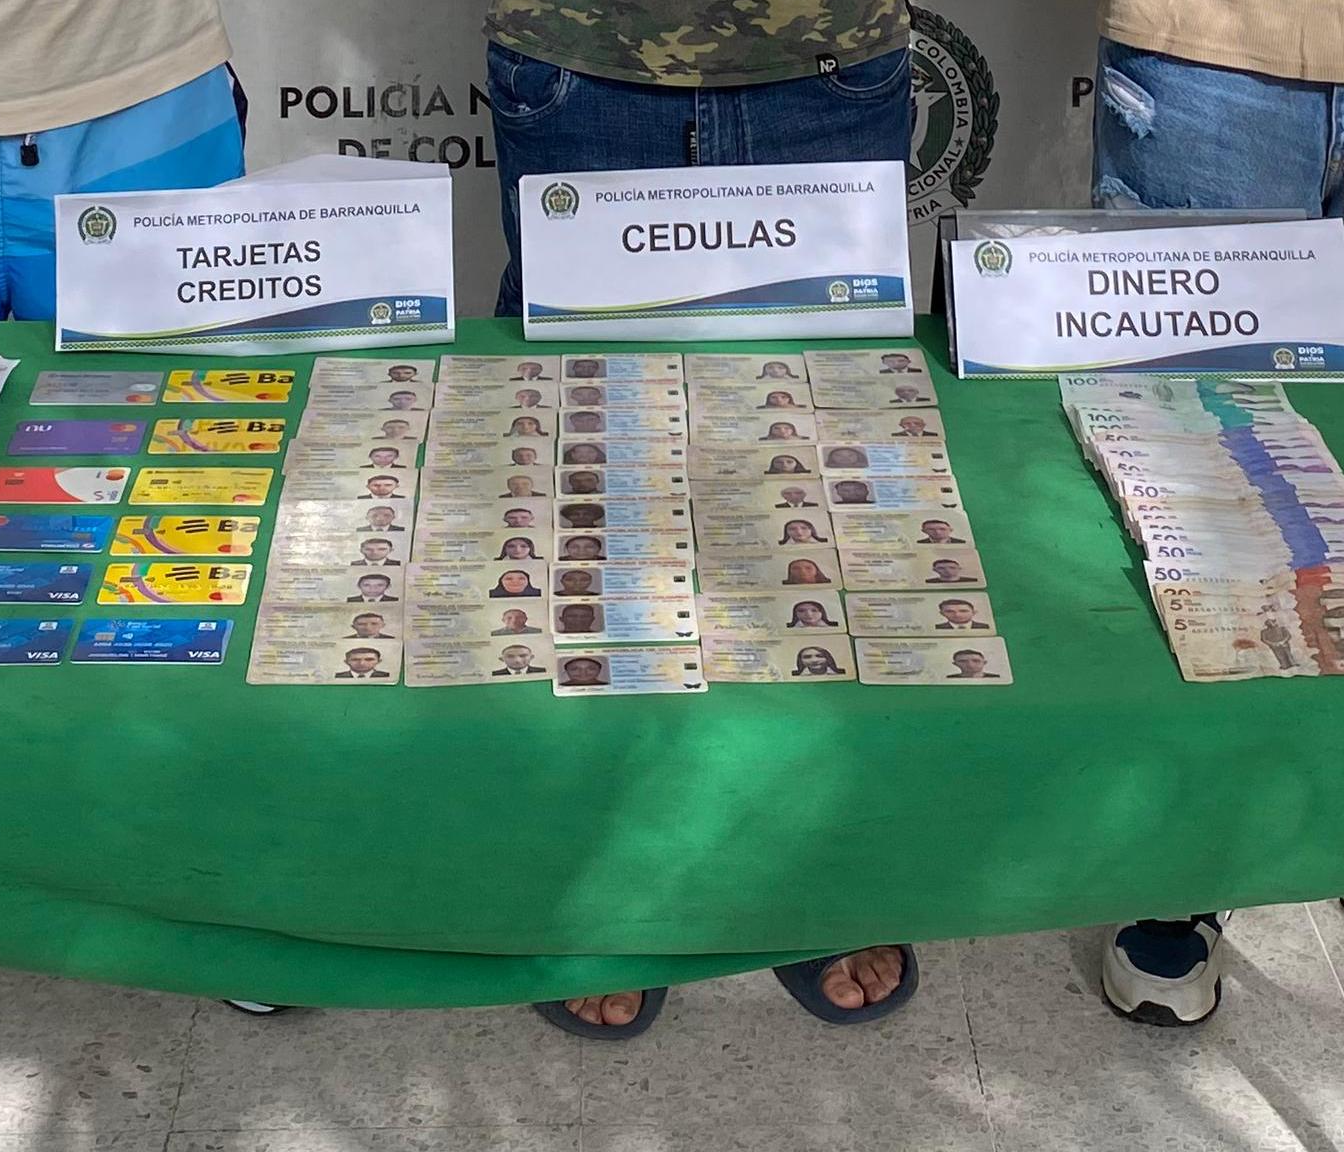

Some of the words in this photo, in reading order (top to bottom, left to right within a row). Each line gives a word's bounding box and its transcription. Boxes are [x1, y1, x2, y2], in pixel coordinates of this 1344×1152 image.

[915, 38, 970, 129] COLOMBIA
[280, 74, 454, 119] POLICÍA
[595, 188, 646, 203] POLICÍA
[648, 186, 753, 201] METROPOLITANA
[756, 185, 772, 196] DE
[776, 182, 874, 196] BARRANQUILLA
[133, 212, 184, 228] POLICÍA
[187, 211, 296, 227] METROPOLITANA
[299, 209, 317, 220] DE
[320, 203, 420, 219] BARRANQUILLA
[622, 218, 797, 253] CEDULAS
[176, 240, 321, 269] TARJETAS
[1029, 249, 1079, 263] POLICÍA
[1082, 250, 1190, 263] METROPOLITANA
[1193, 250, 1211, 262] DE
[1214, 249, 1316, 262] BARRANQUILLA
[177, 275, 322, 304] CREDITOS
[1088, 269, 1220, 296] DINERO
[1056, 310, 1260, 338] INCAUTADO
[1066, 377, 1098, 386] 100
[1133, 485, 1159, 498] 50
[1155, 567, 1182, 581] 50
[47, 592, 79, 600] VISA
[1174, 618, 1187, 631] 5
[26, 651, 58, 659] VISA
[188, 650, 220, 659] VISA
